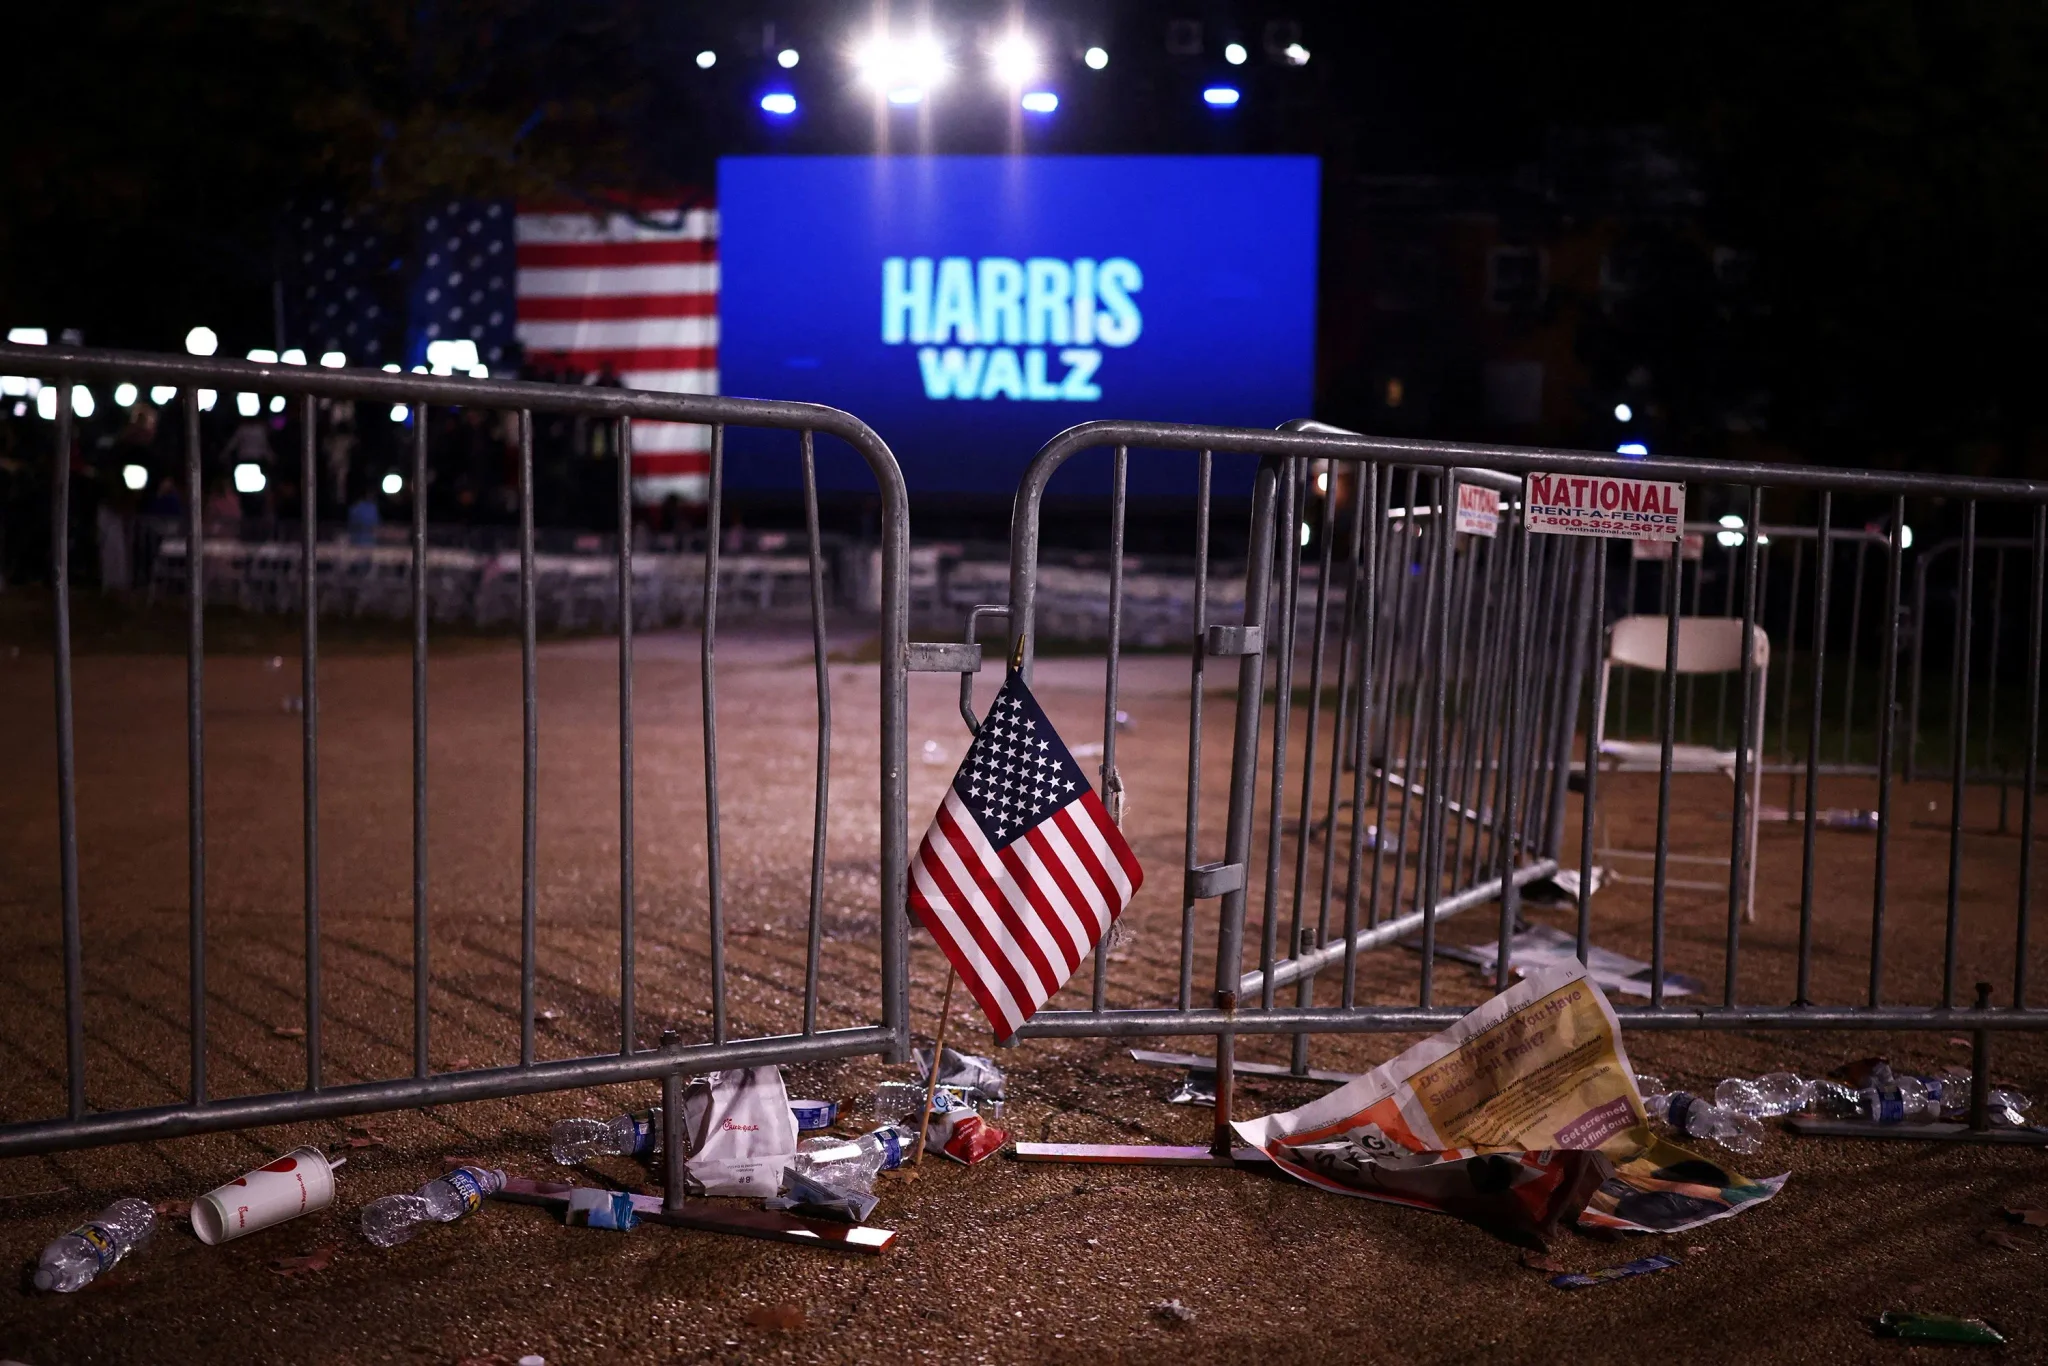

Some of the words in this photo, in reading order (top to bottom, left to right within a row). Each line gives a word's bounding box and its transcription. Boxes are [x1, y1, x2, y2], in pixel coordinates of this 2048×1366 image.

[882, 257, 1143, 346] HARRIS
[918, 348, 1102, 401] WALZ
[1531, 476, 1678, 514] NATIONAL
[1530, 506, 1677, 524] RENT-A-FENCE
[1531, 516, 1677, 534] 1-800-352-5675
[1565, 526, 1641, 536] rentnational.com
[1420, 1075, 1438, 1089] Do
[1440, 1055, 1466, 1076] You
[1466, 1033, 1505, 1060] Know
[1505, 1022, 1517, 1037] if
[1521, 1007, 1545, 1030] You
[1545, 990, 1582, 1014] Have
[1459, 1019, 1498, 1045] SPONSORED
[1501, 999, 1531, 1021] CONTENT
[1429, 1077, 1474, 1106] Sickle
[1503, 1031, 1546, 1061] Trait?
[1561, 1128, 1580, 1144] Get
[1580, 1102, 1627, 1133] screened
[1572, 1137, 1588, 1151] nd
[1587, 1124, 1608, 1141] find
[1608, 1115, 1631, 1131] out!
[448, 1177, 470, 1200] PARK
[456, 1175, 476, 1196] DEER
